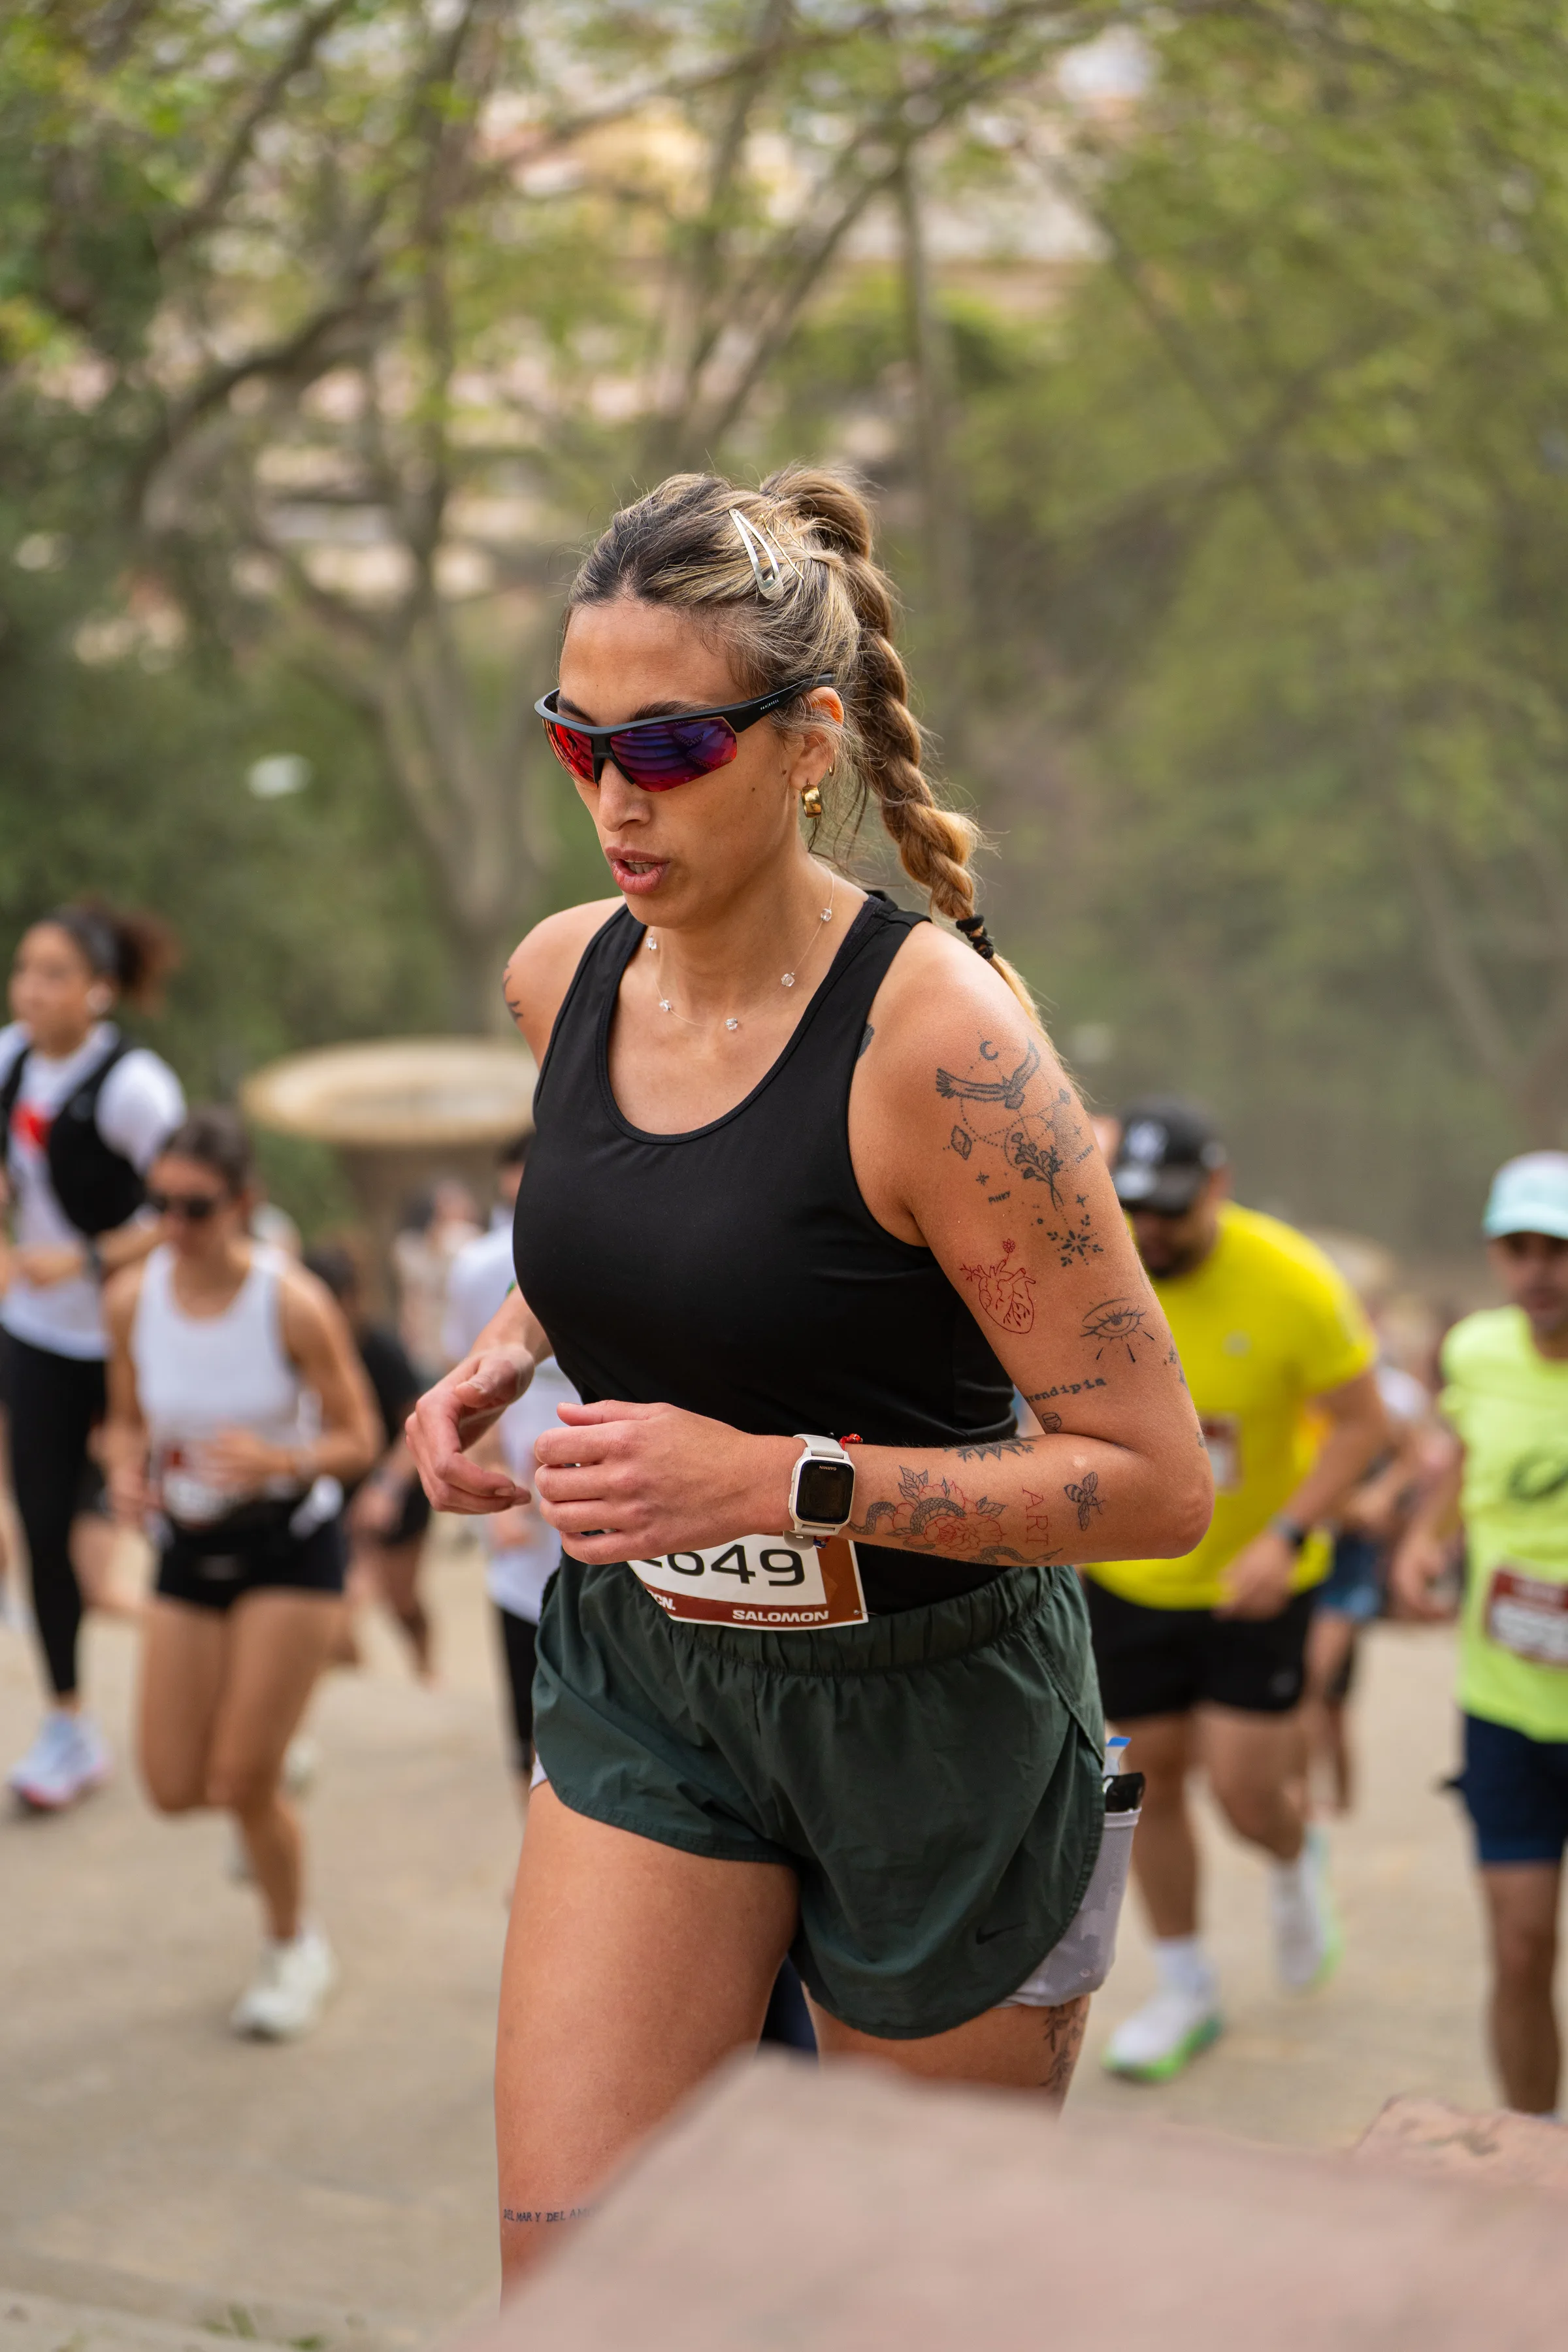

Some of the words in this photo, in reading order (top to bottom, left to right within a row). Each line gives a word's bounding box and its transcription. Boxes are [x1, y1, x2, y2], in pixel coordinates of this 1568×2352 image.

[1022, 1486, 1049, 1546] ART
[641, 1544, 805, 1587] 649
[732, 1609, 829, 1622] SALOMON
[504, 2208, 514, 2221] DEL
[516, 2212, 532, 2222] MAR
[534, 2212, 542, 2222] Y
[546, 2211, 566, 2222] DEL
